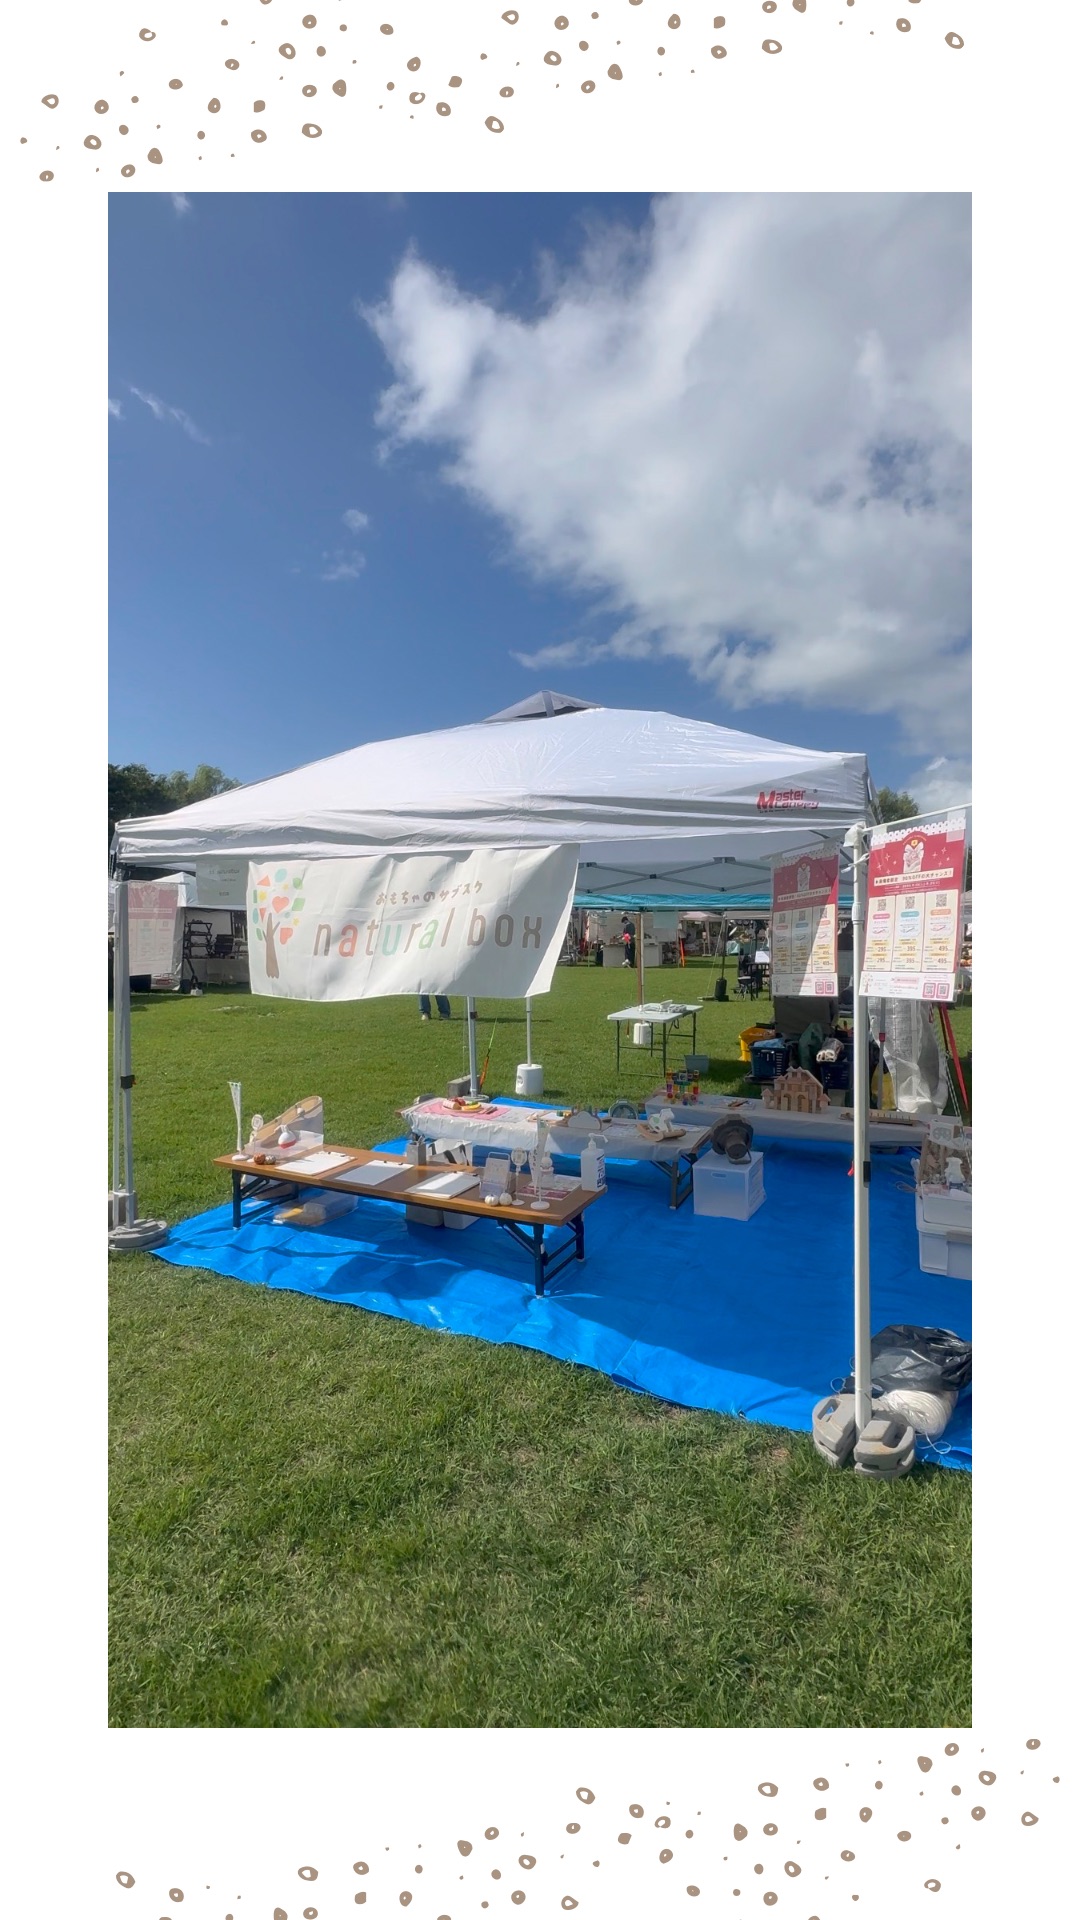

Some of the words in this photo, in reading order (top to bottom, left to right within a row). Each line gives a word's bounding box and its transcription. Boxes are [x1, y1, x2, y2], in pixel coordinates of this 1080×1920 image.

[757, 789, 806, 809] Master
[375, 880, 483, 906] おもちゃのサブスク
[313, 907, 456, 958] natural
[467, 908, 542, 949] box
